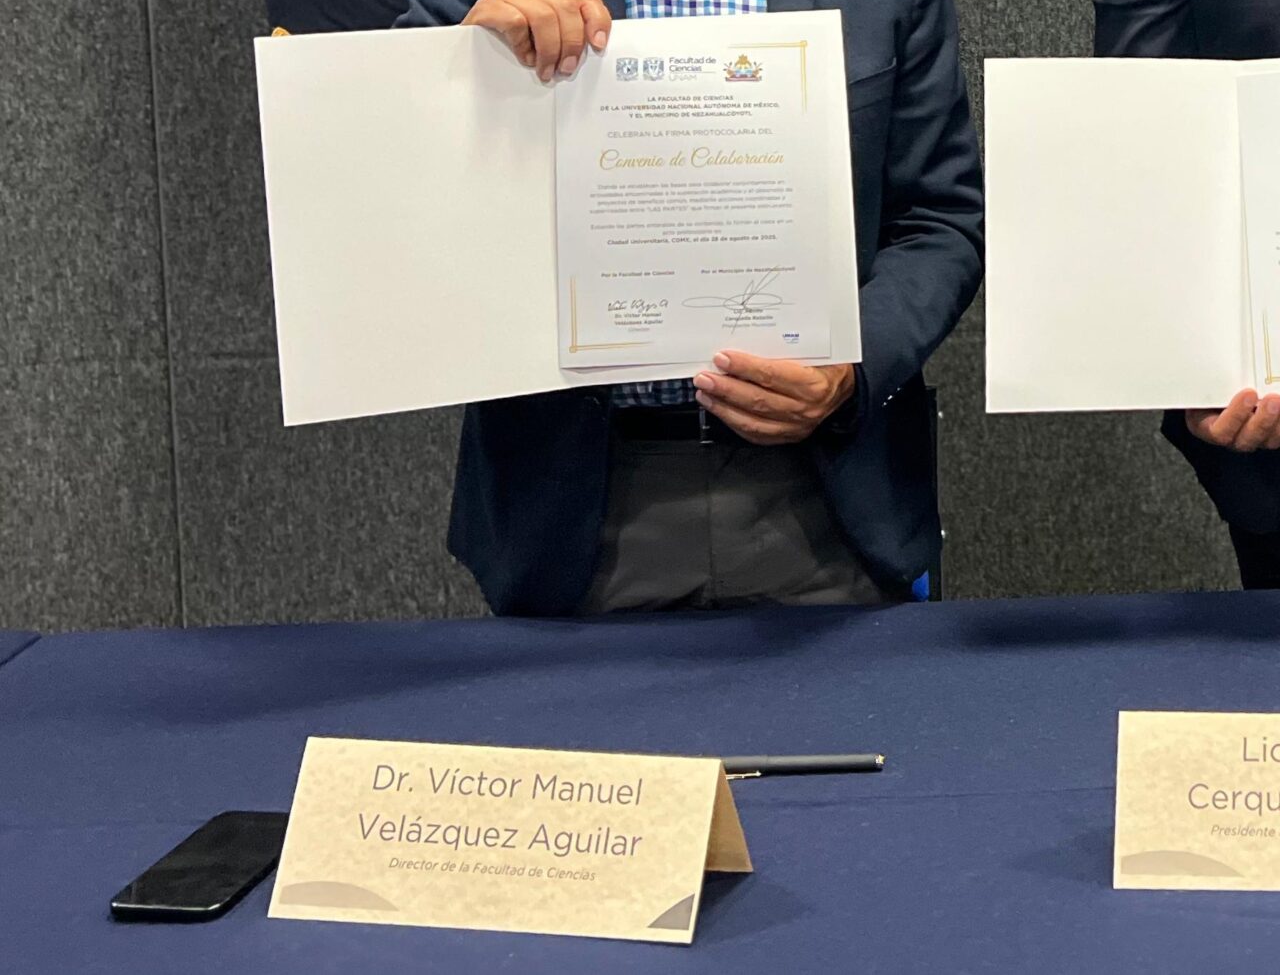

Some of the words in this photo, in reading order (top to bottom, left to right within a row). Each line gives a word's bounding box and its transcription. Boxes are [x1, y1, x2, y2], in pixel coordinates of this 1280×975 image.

[668, 56, 705, 65] Facultad
[668, 64, 703, 73] Ciencias
[692, 128, 756, 136] PROTOCOLARIA
[600, 148, 663, 170] Convenio
[670, 151, 685, 167] de
[691, 147, 784, 168] Colaboración
[372, 764, 413, 792] Dr.
[429, 767, 522, 798] Víctor
[532, 774, 642, 805] Manuel
[358, 813, 518, 850] Velázquez
[528, 824, 642, 857] Aguilar
[1210, 825, 1276, 838] Presidente
[388, 858, 438, 871] Director
[440, 860, 456, 872] de
[458, 861, 470, 873] la
[472, 862, 525, 877] Facultad
[528, 866, 543, 878] de
[546, 866, 596, 881] Ciencias
